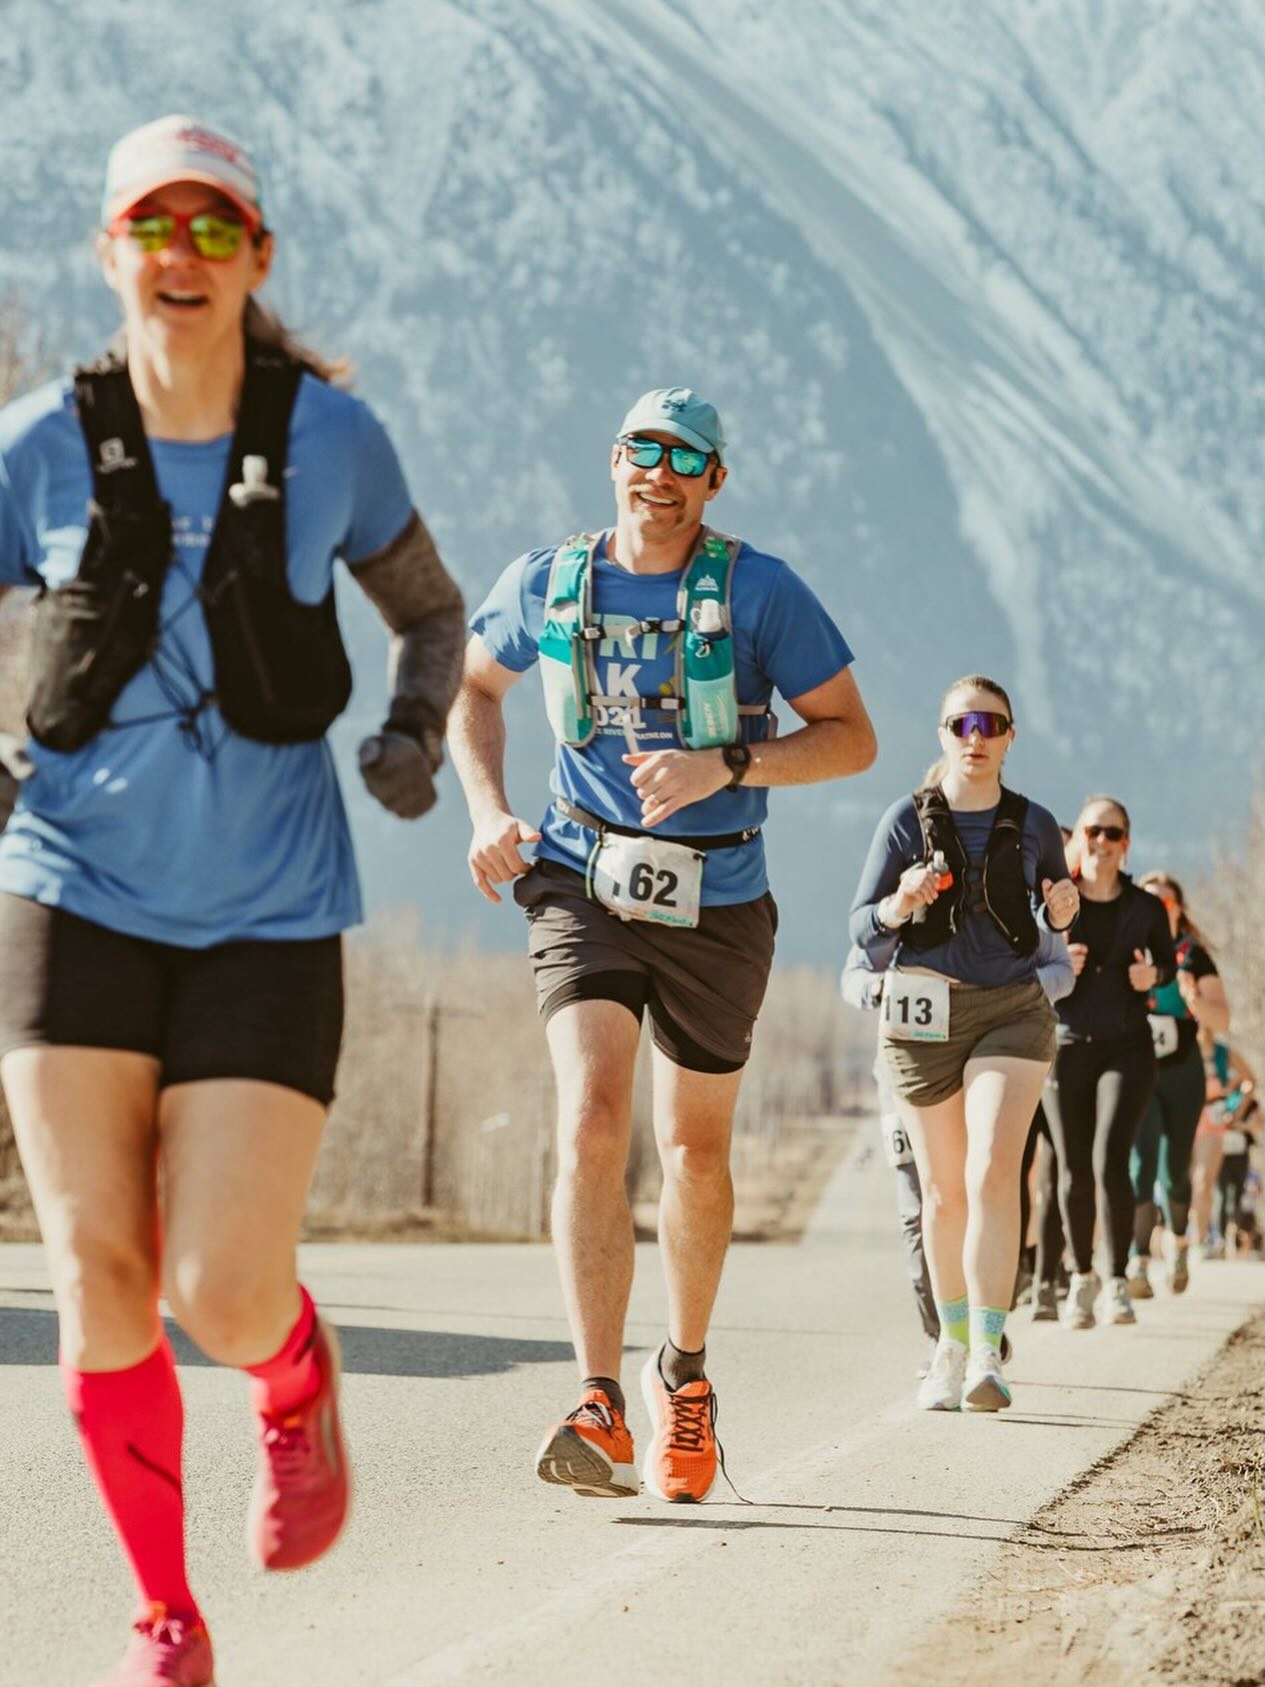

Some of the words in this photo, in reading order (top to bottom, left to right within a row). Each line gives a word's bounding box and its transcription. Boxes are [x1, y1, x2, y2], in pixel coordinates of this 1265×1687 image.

[592, 613, 660, 660] RI
[592, 662, 641, 697] K
[892, 1129, 912, 1154] 6
